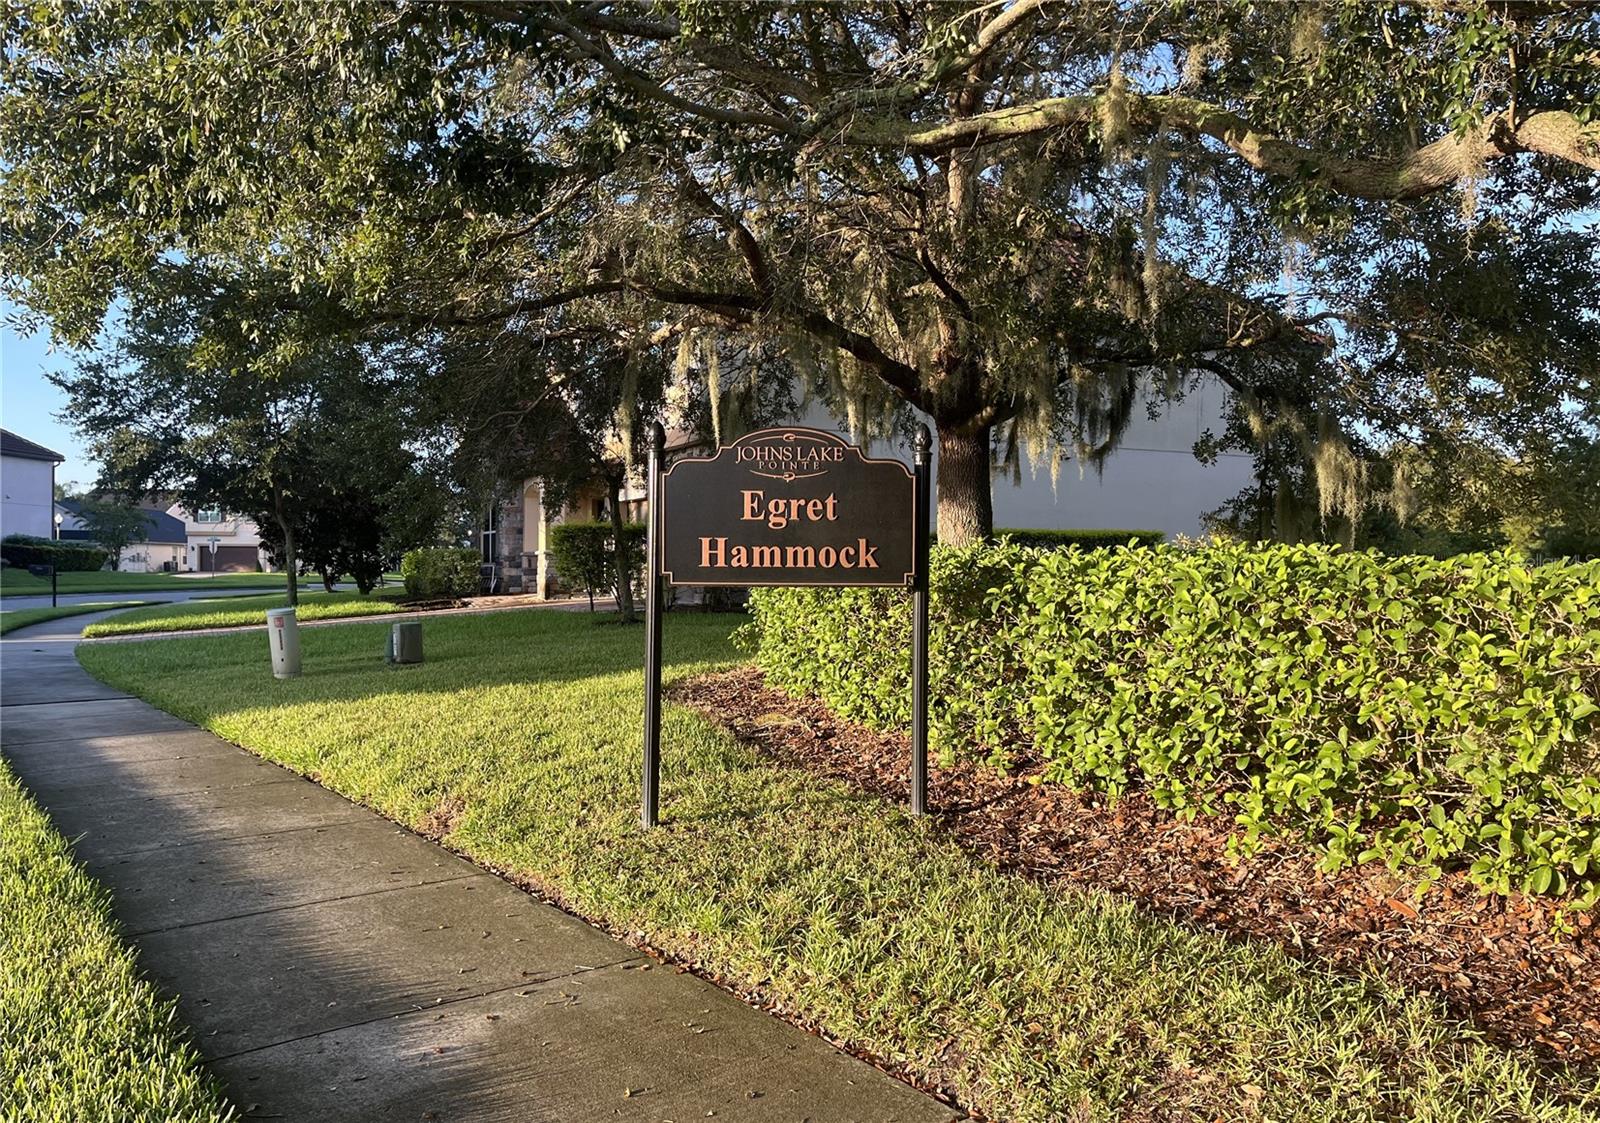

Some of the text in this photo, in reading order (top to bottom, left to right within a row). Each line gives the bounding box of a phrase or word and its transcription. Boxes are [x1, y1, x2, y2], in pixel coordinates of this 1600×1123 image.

[736, 446, 844, 464] JOHNS LAKE
[759, 461, 821, 470] POINTE
[740, 490, 838, 529] Egret
[698, 537, 879, 568] Hammock
